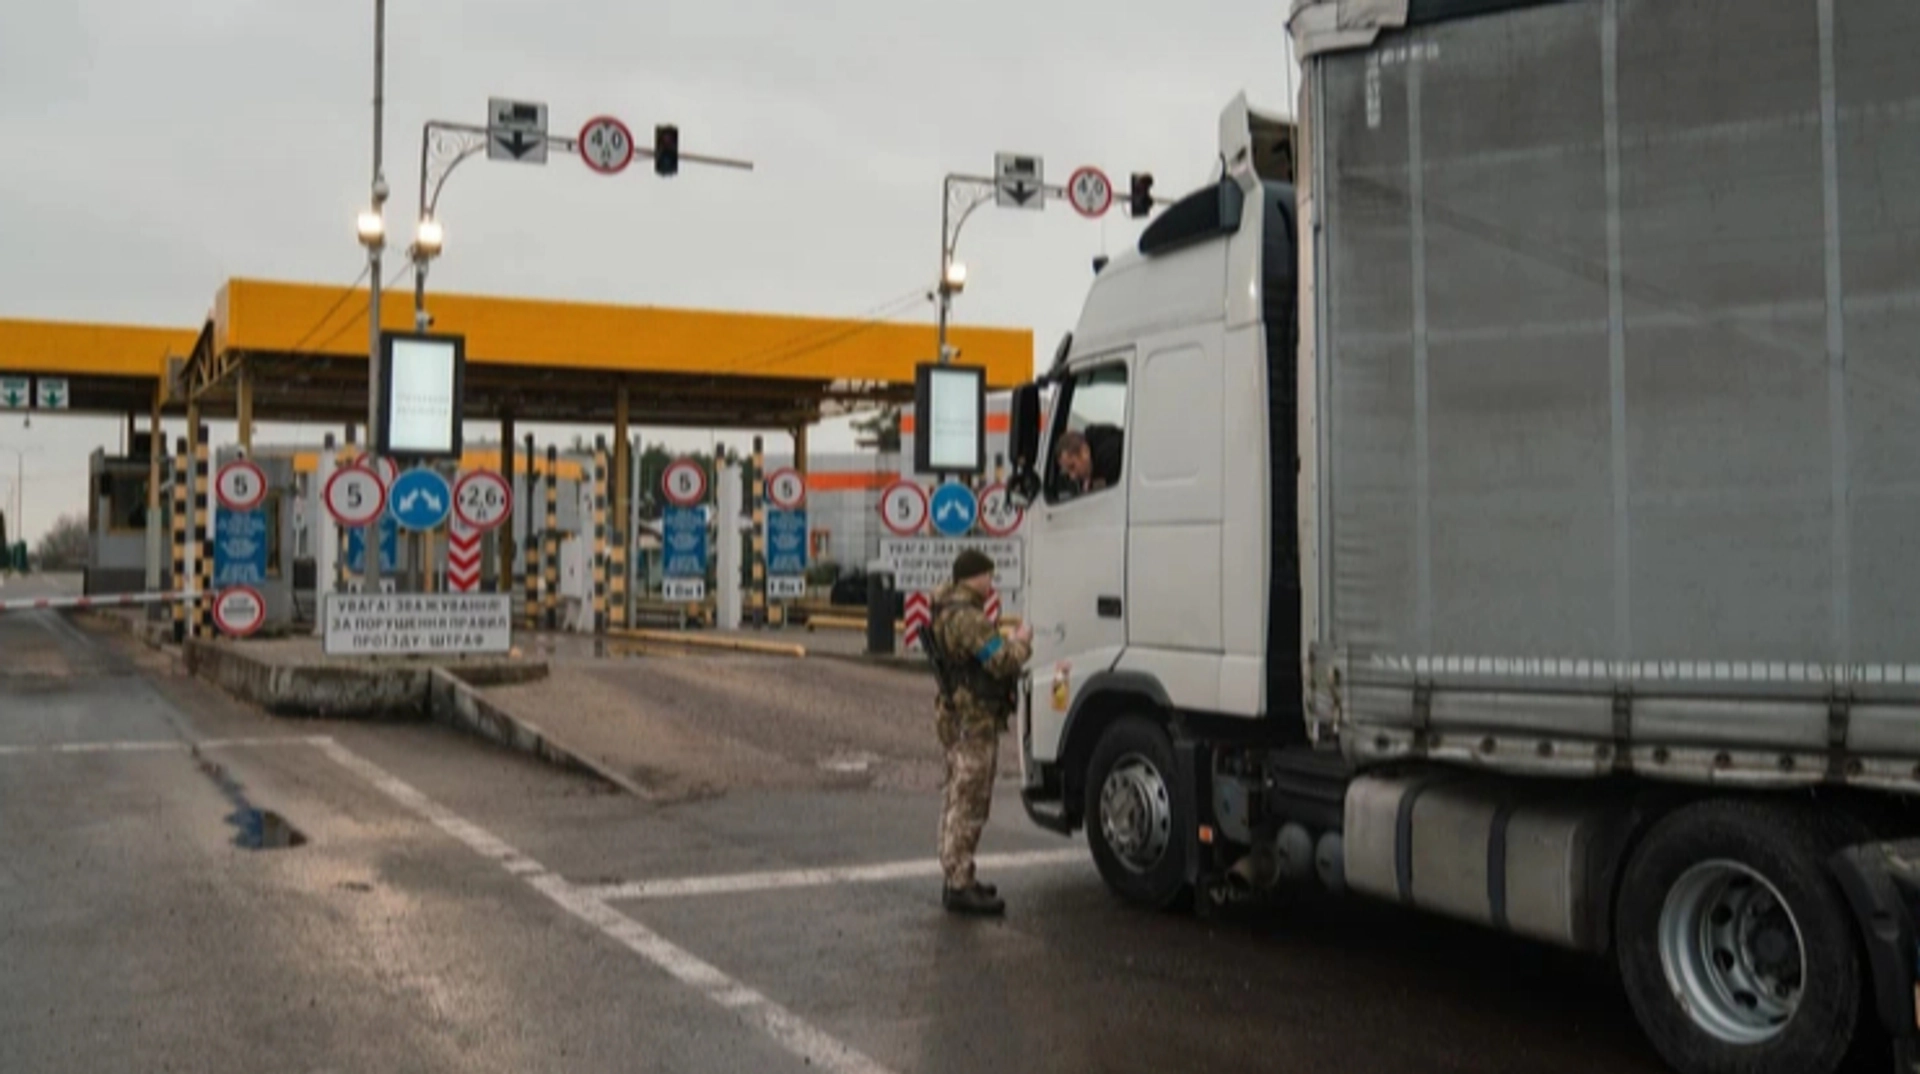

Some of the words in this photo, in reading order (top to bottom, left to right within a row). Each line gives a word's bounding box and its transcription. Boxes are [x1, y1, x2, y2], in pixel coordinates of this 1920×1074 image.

[234, 475, 247, 496] 5
[680, 473, 691, 493] 5
[348, 483, 361, 507] 5
[467, 484, 497, 509] 2,6
[898, 497, 910, 519] 5
[337, 599, 390, 612] УВАГА!
[396, 599, 501, 612] ЗВАЖУВАННЯ
[332, 617, 350, 631] ЗА
[355, 617, 448, 631] ПОРУШЕННЯ
[449, 617, 507, 630] ПРАВИЛ
[353, 633, 420, 648] ПРОЇЗДУ
[429, 633, 484, 648] ШТРАФ
